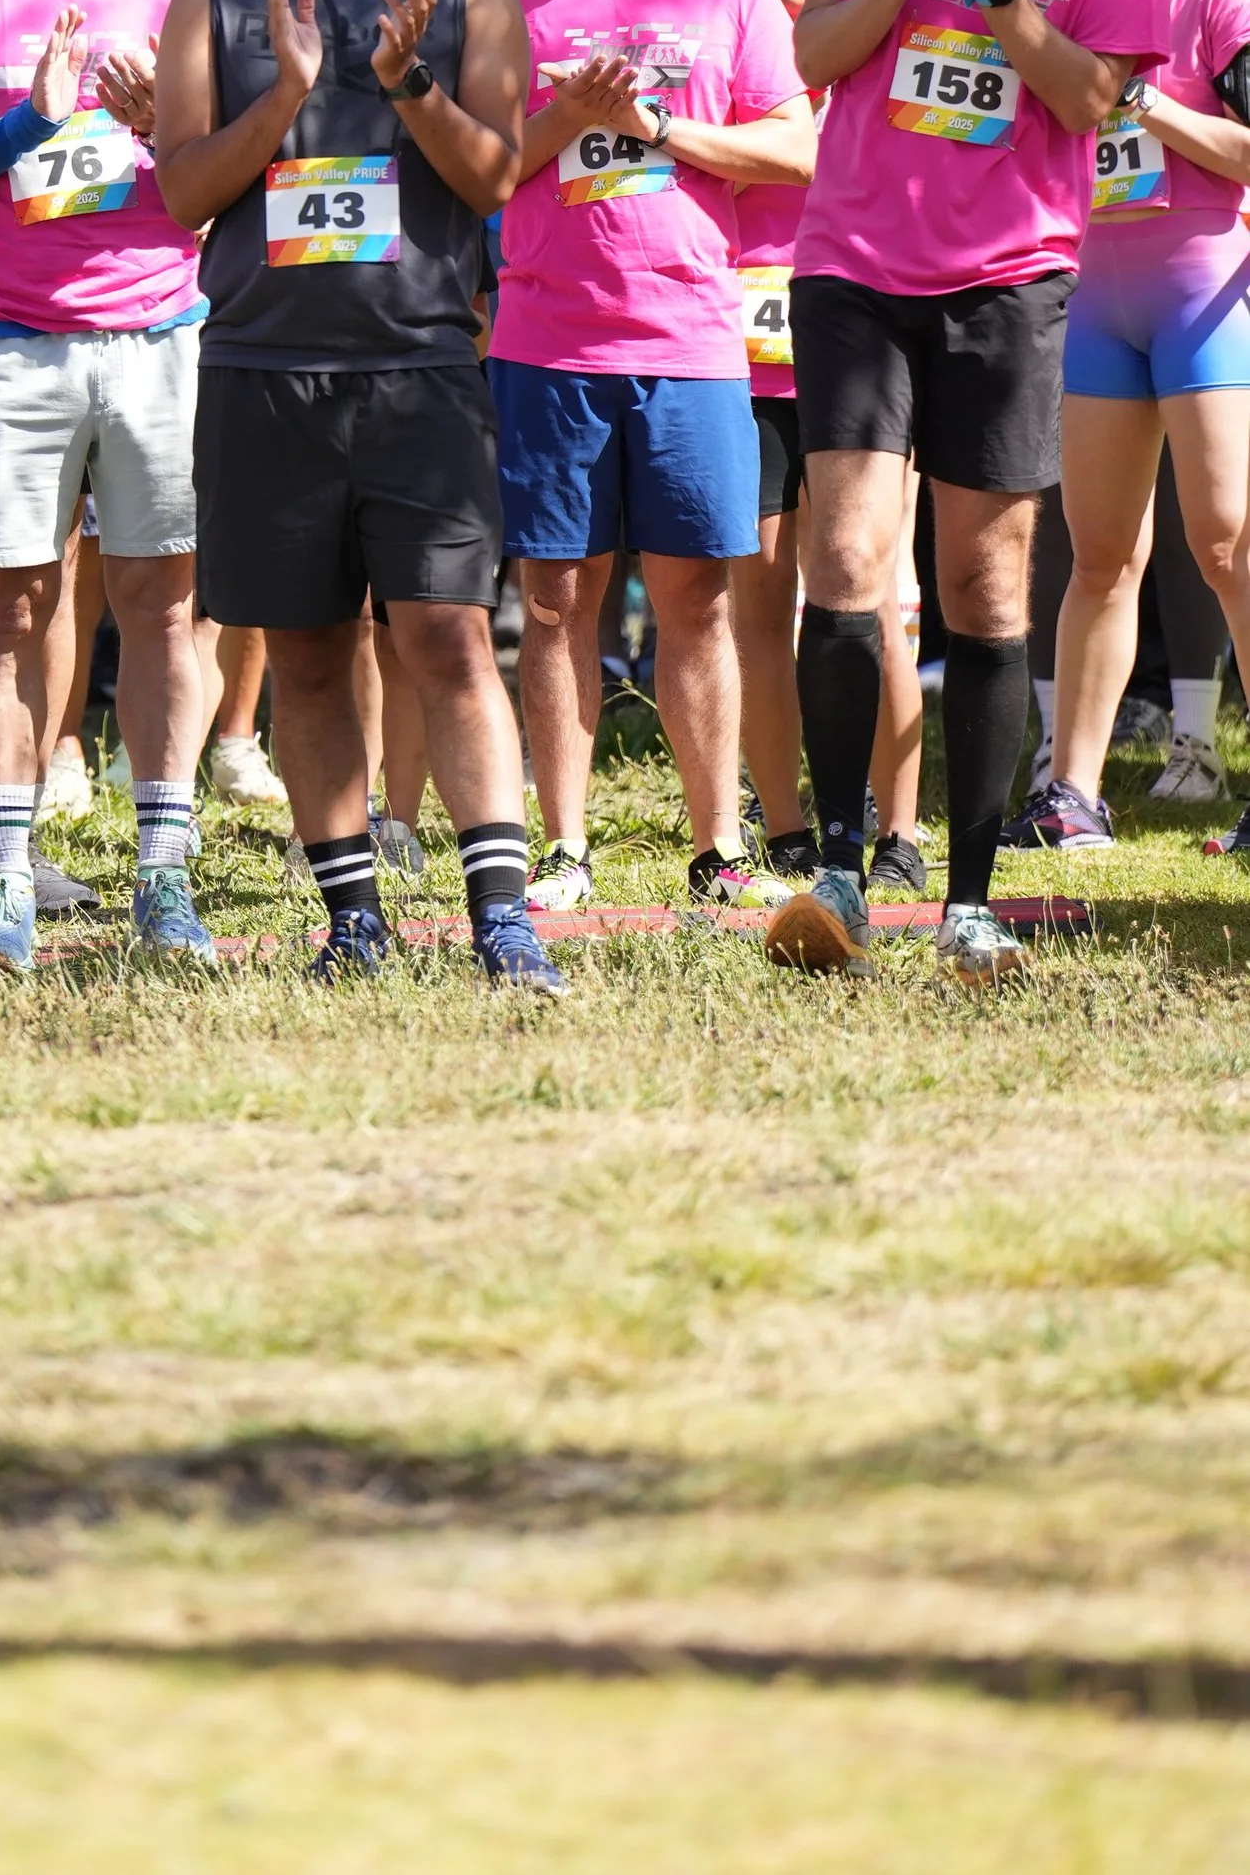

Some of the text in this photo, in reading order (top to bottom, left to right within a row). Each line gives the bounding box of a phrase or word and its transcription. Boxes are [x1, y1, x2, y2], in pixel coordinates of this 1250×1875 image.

[910, 33, 1009, 62] Silicon Valley PRI
[912, 60, 1004, 111] 158
[923, 111, 939, 124] 5K
[947, 116, 974, 131] 2025
[56, 123, 85, 138] alley
[580, 132, 645, 170] 64
[38, 145, 103, 188] 76
[274, 167, 389, 184] Silicon Valley PRIDE
[592, 178, 606, 191] 5K
[1109, 182, 1130, 194] 2025
[76, 191, 100, 205] 2025
[298, 191, 366, 229] 43
[332, 239, 357, 252] 2025
[762, 344, 775, 355] 5K
